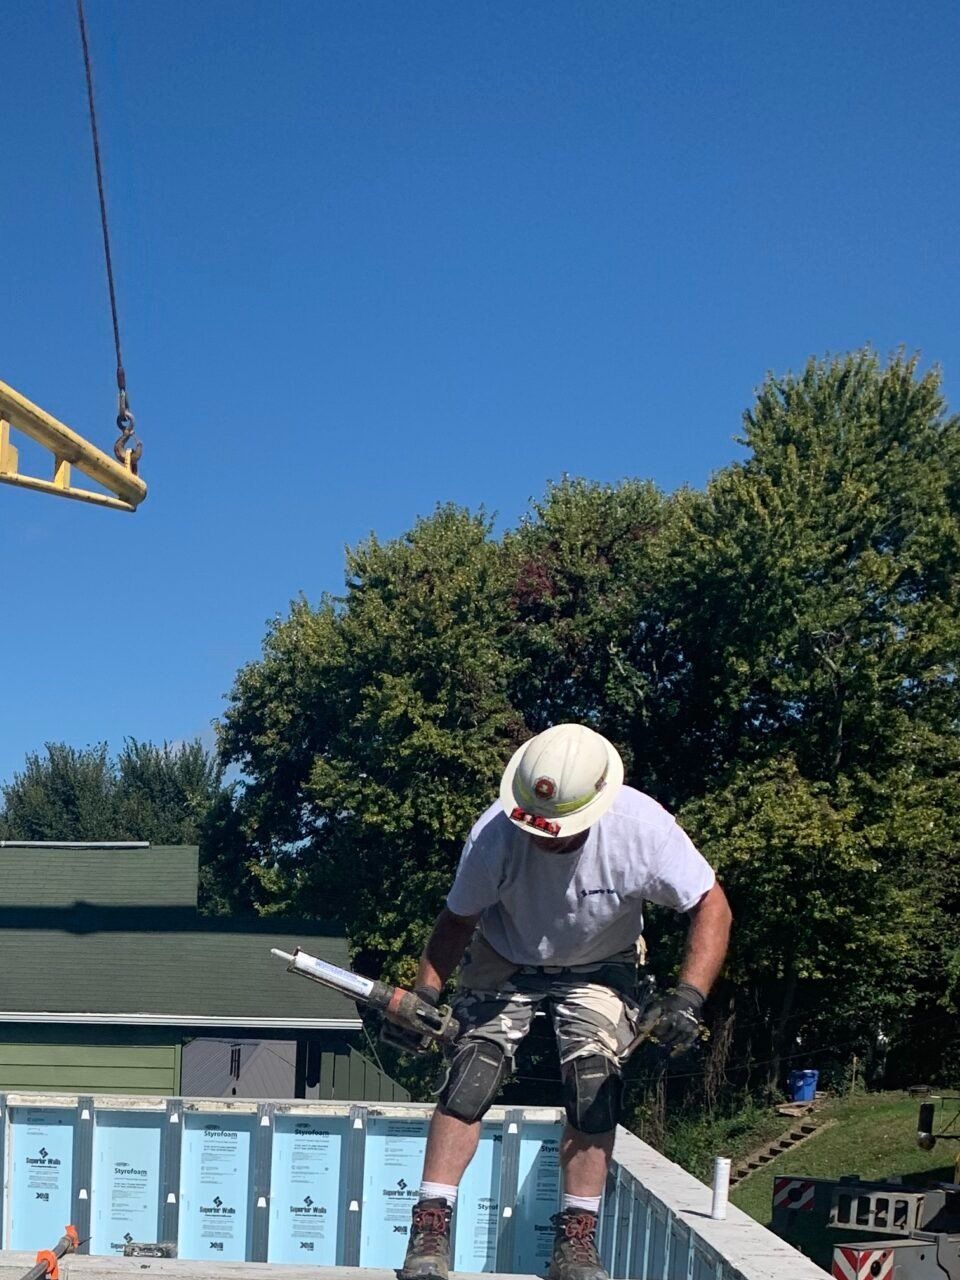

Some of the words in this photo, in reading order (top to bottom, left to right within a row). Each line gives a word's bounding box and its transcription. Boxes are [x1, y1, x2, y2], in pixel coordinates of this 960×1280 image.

[203, 1130, 238, 1138] Styrofoam
[294, 1128, 330, 1137] Styrofoam
[114, 1167, 148, 1176] Styrofoam
